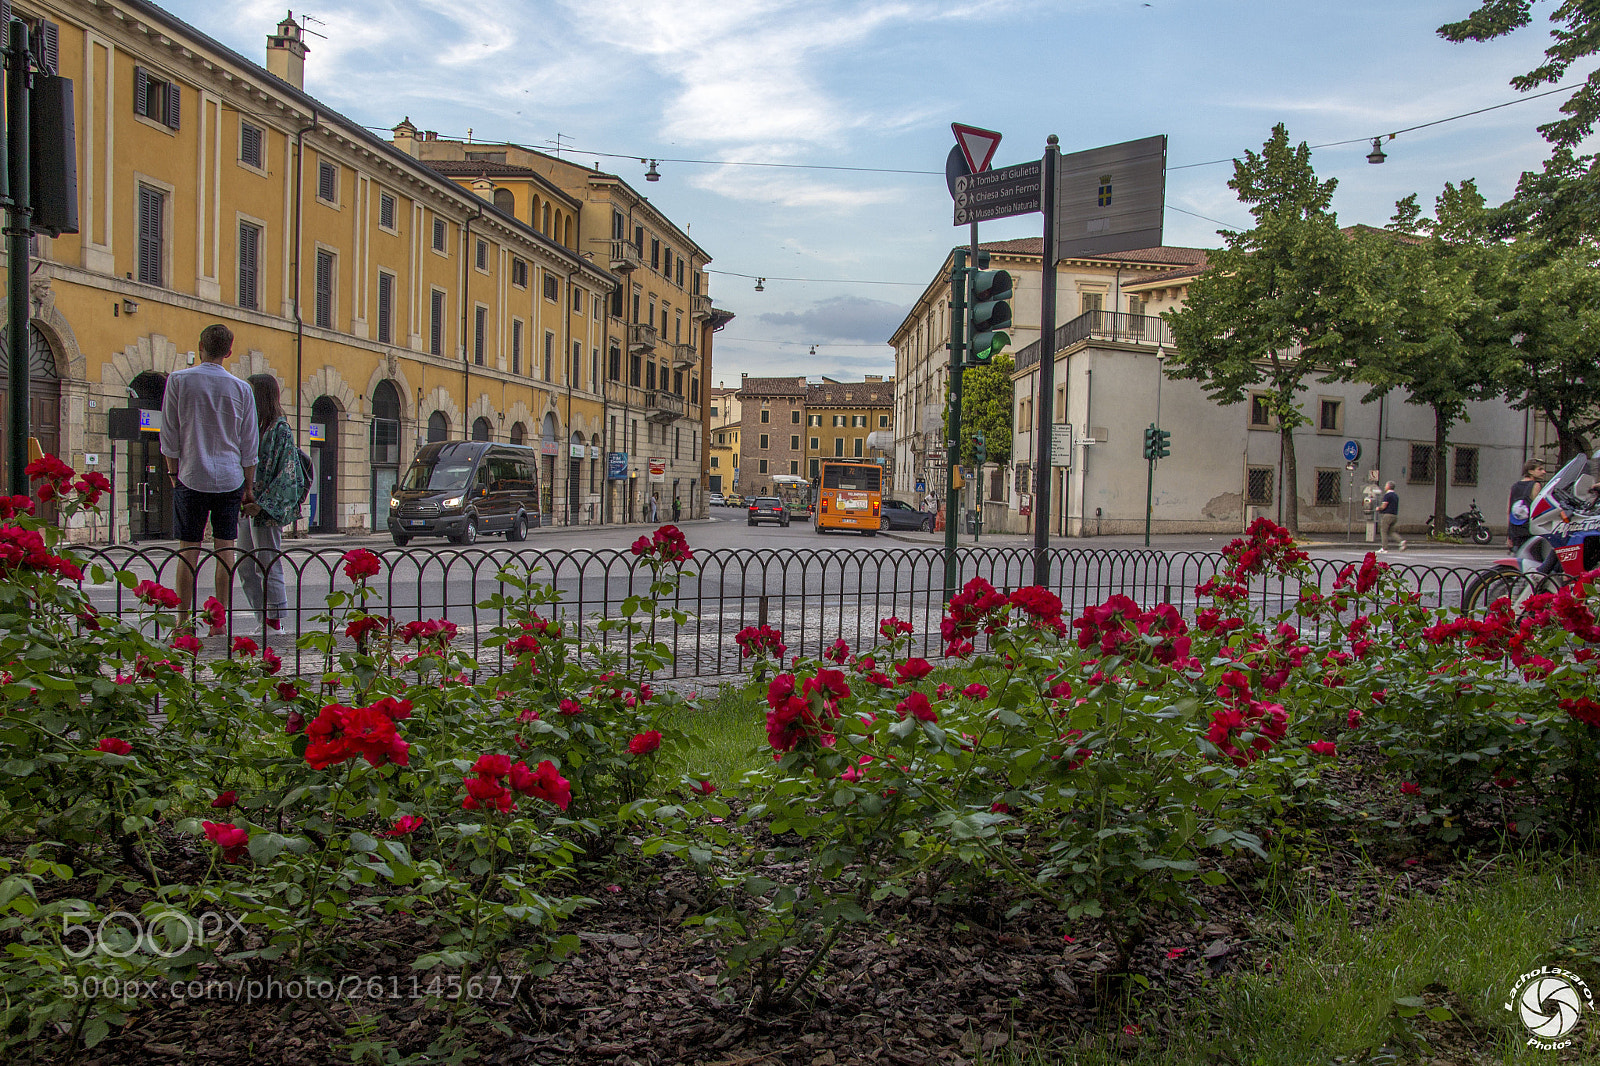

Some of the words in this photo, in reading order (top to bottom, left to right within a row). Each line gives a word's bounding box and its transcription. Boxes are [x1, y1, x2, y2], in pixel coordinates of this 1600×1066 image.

[976, 174, 999, 186] Tomba
[1000, 171, 1007, 181] di
[1008, 166, 1039, 179] Giulietta
[975, 191, 999, 201] Chiesa
[1000, 188, 1014, 197] San
[1015, 183, 1040, 195] Fermo
[975, 208, 994, 218] Museo
[995, 204, 1012, 215] Storia
[1012, 199, 1038, 211] Naturale
[1555, 546, 1580, 554] HONDA
